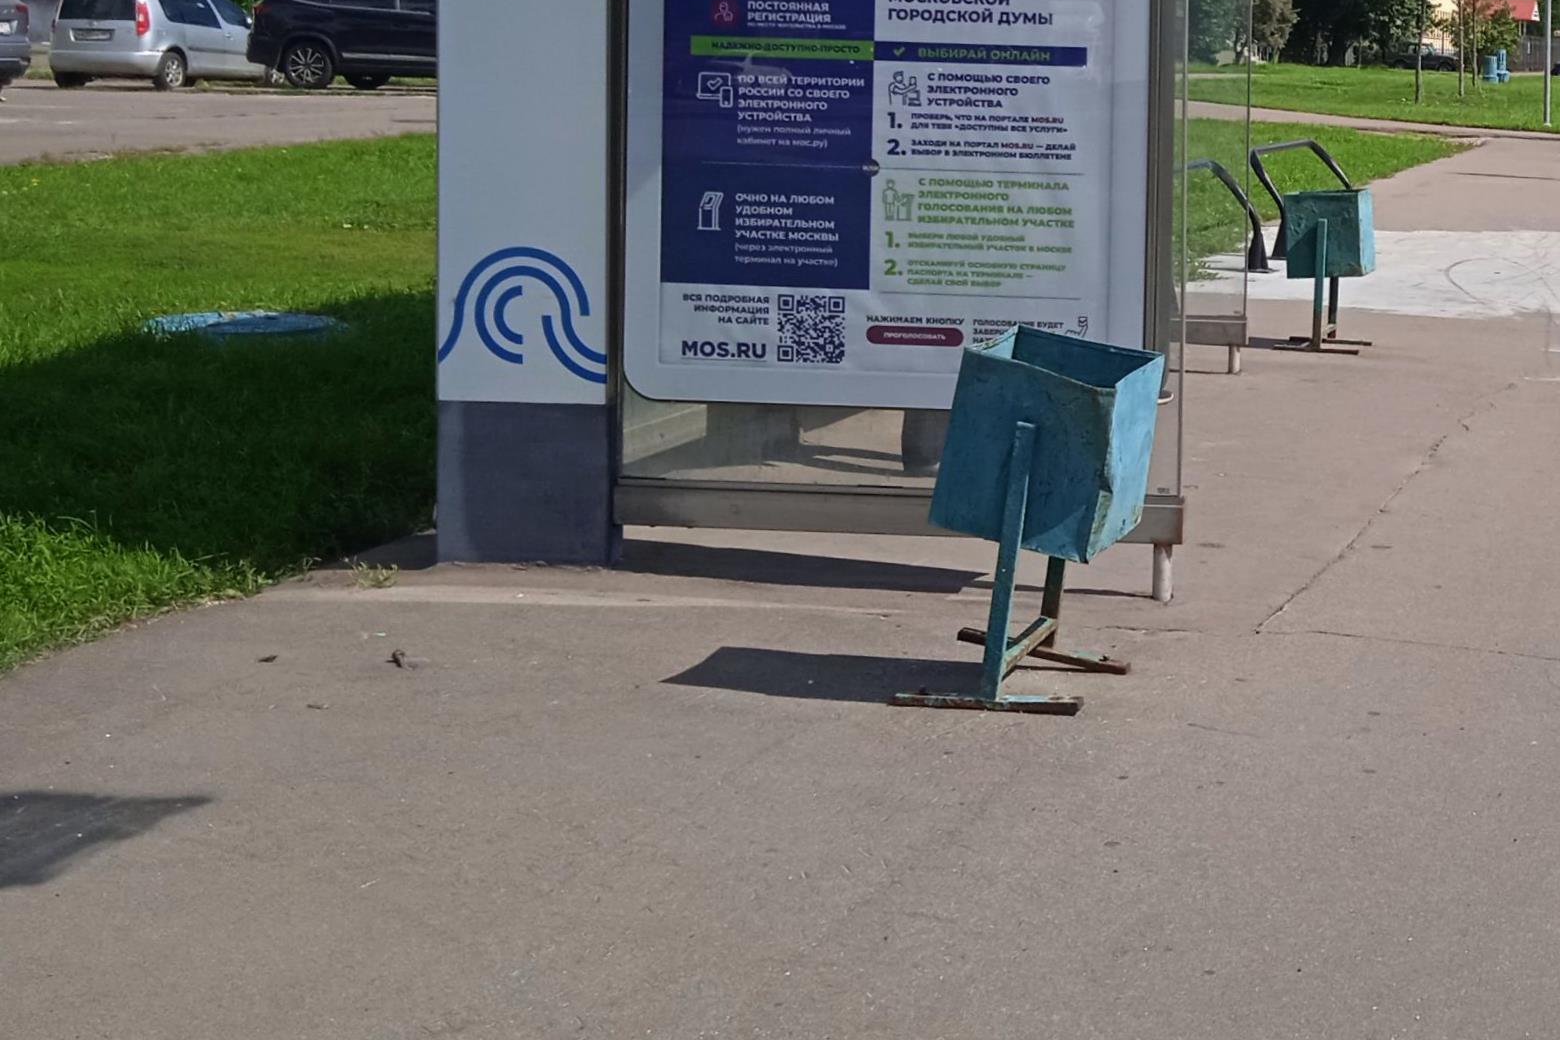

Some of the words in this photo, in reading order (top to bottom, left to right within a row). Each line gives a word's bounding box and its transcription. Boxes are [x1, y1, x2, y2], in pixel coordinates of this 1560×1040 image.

[747, 1, 829, 12] ПОСТОЯННАЯ
[747, 12, 832, 23] РЕГИСТРАЦИЯ
[888, 8, 993, 23] ГОРОДСКОЙ
[997, 11, 1053, 26] ДУМЫ
[918, 47, 988, 59] ВЫБИРАЙ
[990, 48, 1050, 61] ОНЛАЙН
[738, 75, 755, 84] ПО
[758, 74, 788, 85] ВСЕЙ
[791, 76, 865, 87] ТЕРРИТОРИИ
[928, 73, 935, 81] С
[938, 73, 1003, 84] ПОМОЩЬЮ
[1005, 75, 1050, 85] СВОЕГО
[738, 87, 785, 97] РОССИИ
[787, 88, 803, 98] СО
[806, 89, 850, 99] СВОЕГО
[927, 85, 1019, 96] ЭЛЕКТРОННОГО
[737, 99, 827, 110] ЭЛЕКТРОННОГО
[927, 97, 1003, 108] УСТРОЙСТВА
[737, 111, 812, 122] УСТРОЙСТВА
[887, 112, 903, 129] 1.
[887, 138, 907, 155] 2.
[918, 178, 926, 186] С
[929, 179, 993, 190] ПОМОЩЬЮ
[997, 180, 1069, 191] ТЕРМИНАЛА
[736, 193, 768, 203] ОЧНО
[771, 194, 787, 203] НА
[789, 194, 835, 205] ЛЮБОМ
[918, 191, 1009, 201] ЭЛЕКТРОННОГО
[735, 205, 793, 216] УДОБНОМ
[918, 202, 1004, 213] ГОЛОСОВАНИЯ
[1007, 205, 1023, 214] НА
[1026, 206, 1072, 216] ЛЮБОМ
[735, 218, 835, 229] ИЗБИРАТЕЛЬНОМ
[918, 215, 1019, 226] ИЗБИРАТЕЛЬНОМ
[1022, 218, 1075, 229] УЧАСТКЕ
[735, 229, 786, 240] УЧАСТКЕ
[788, 231, 839, 242] МОСКВЫ
[885, 231, 900, 248] 1.
[884, 259, 903, 276] 2.
[683, 294, 702, 302] ВСЯ
[705, 294, 769, 304] ПОДРОБНАЯ
[694, 304, 769, 315] ИНФОРМАЦИЯ
[718, 316, 734, 324] НА
[736, 315, 769, 326] САЙТЕ
[866, 315, 923, 324] НАЖИМАЕМ
[926, 317, 965, 326] КНОПКУ
[681, 340, 767, 359] MOS.RU
